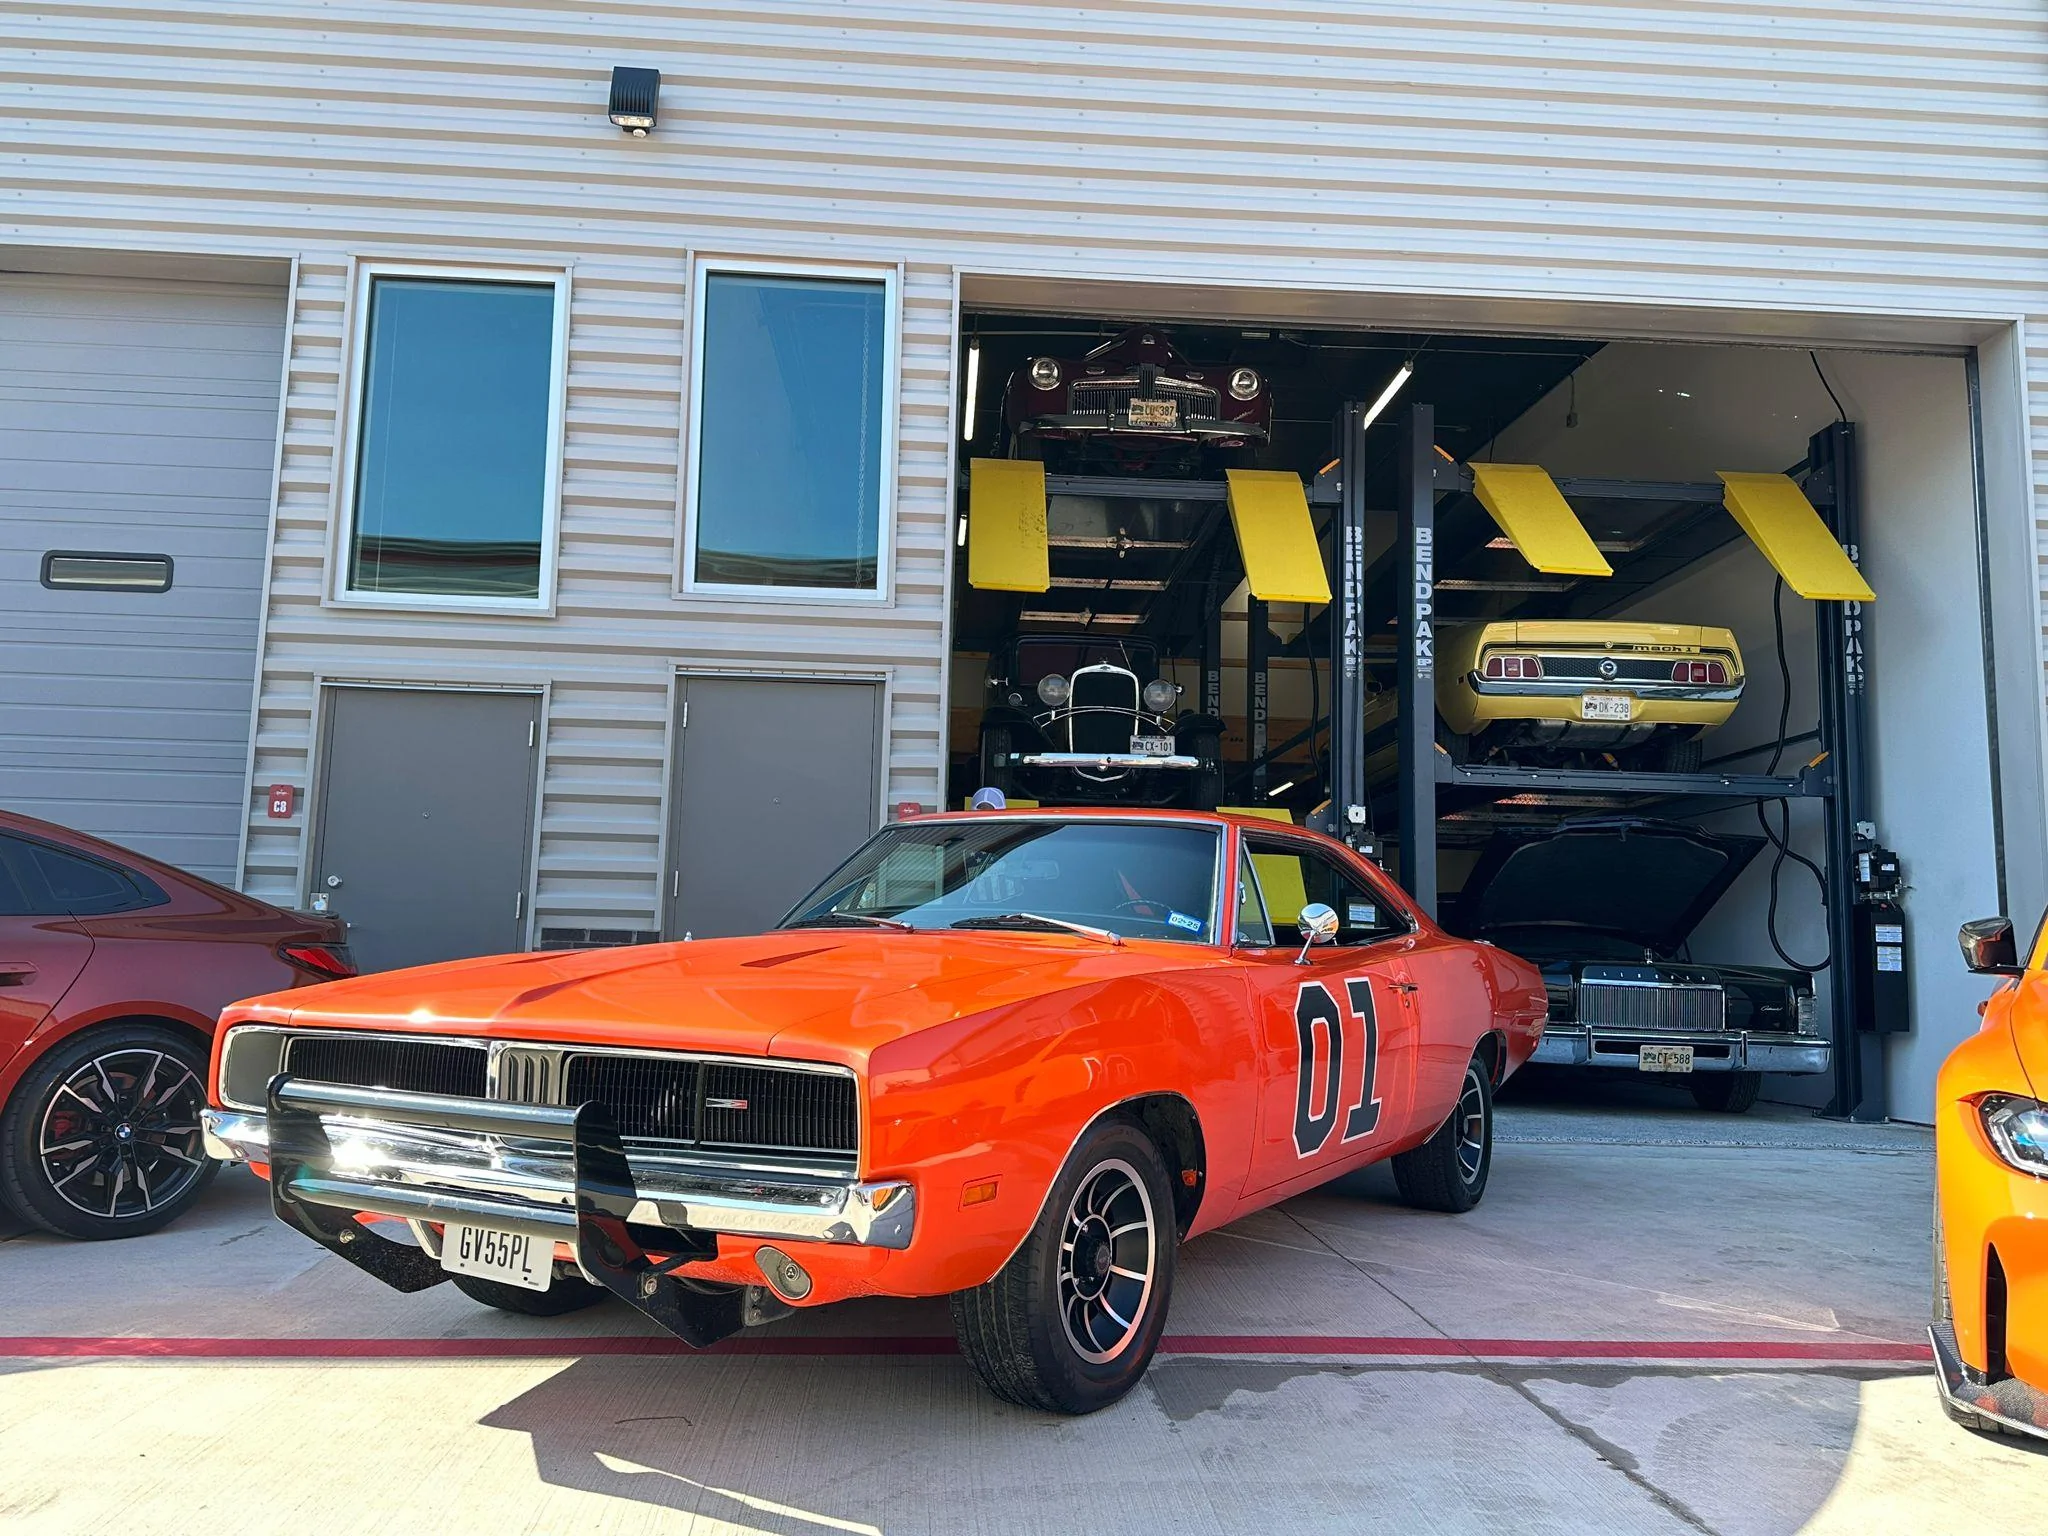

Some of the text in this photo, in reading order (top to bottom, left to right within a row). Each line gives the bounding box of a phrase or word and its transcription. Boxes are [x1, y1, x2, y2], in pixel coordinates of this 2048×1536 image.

[1345, 526, 1362, 656] BENDPAK
[1415, 527, 1433, 657] BENDPAK
[1599, 701, 1629, 714] DK-238
[1145, 741, 1172, 752] CX-101
[273, 800, 287, 813] C8
[1292, 976, 1382, 1160] 01
[1657, 1052, 1691, 1065] CT-588
[460, 1226, 532, 1274] GV55PL
